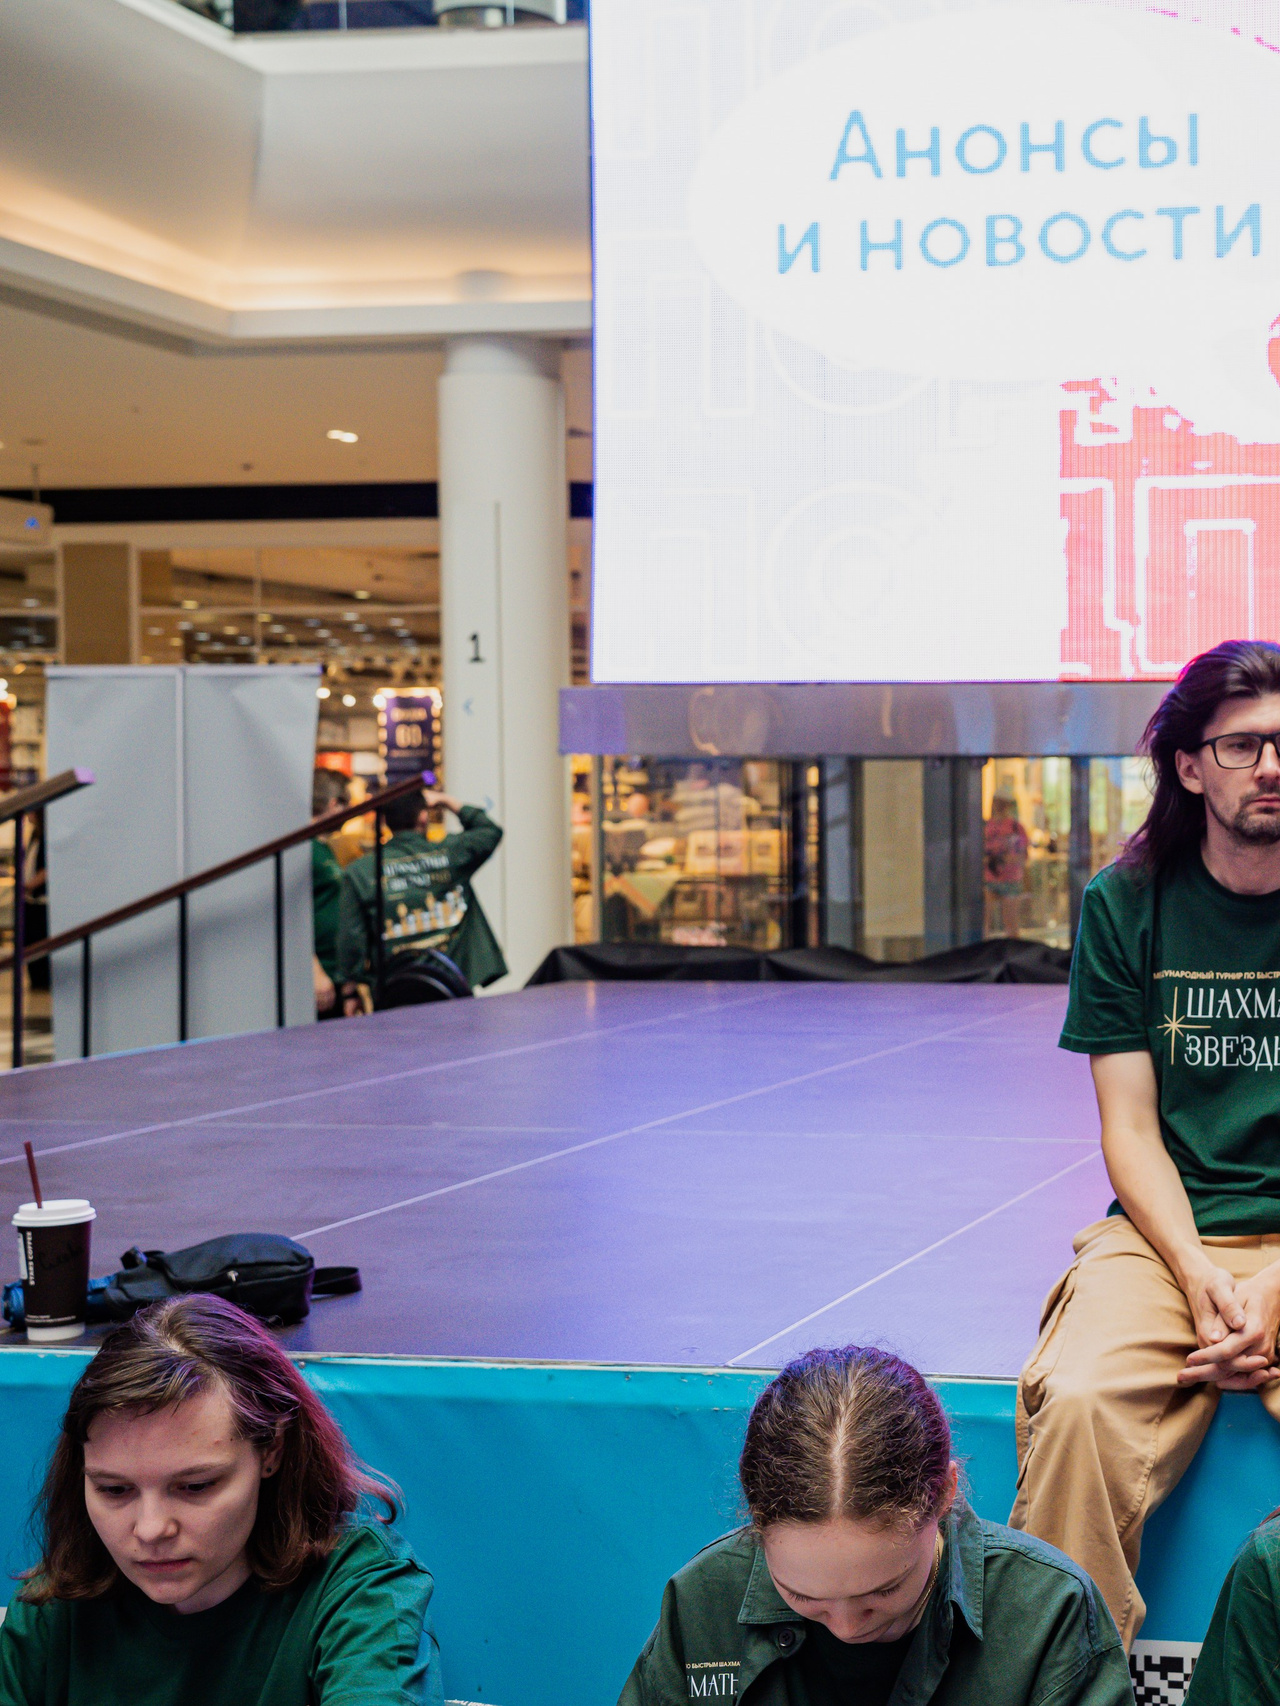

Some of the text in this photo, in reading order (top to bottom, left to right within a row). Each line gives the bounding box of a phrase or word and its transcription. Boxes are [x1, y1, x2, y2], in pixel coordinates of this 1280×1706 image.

[829, 109, 1199, 181] Анонсы
[777, 203, 1262, 275] и новости
[469, 632, 486, 664] 1
[719, 1660, 741, 1668] ШАХМА
